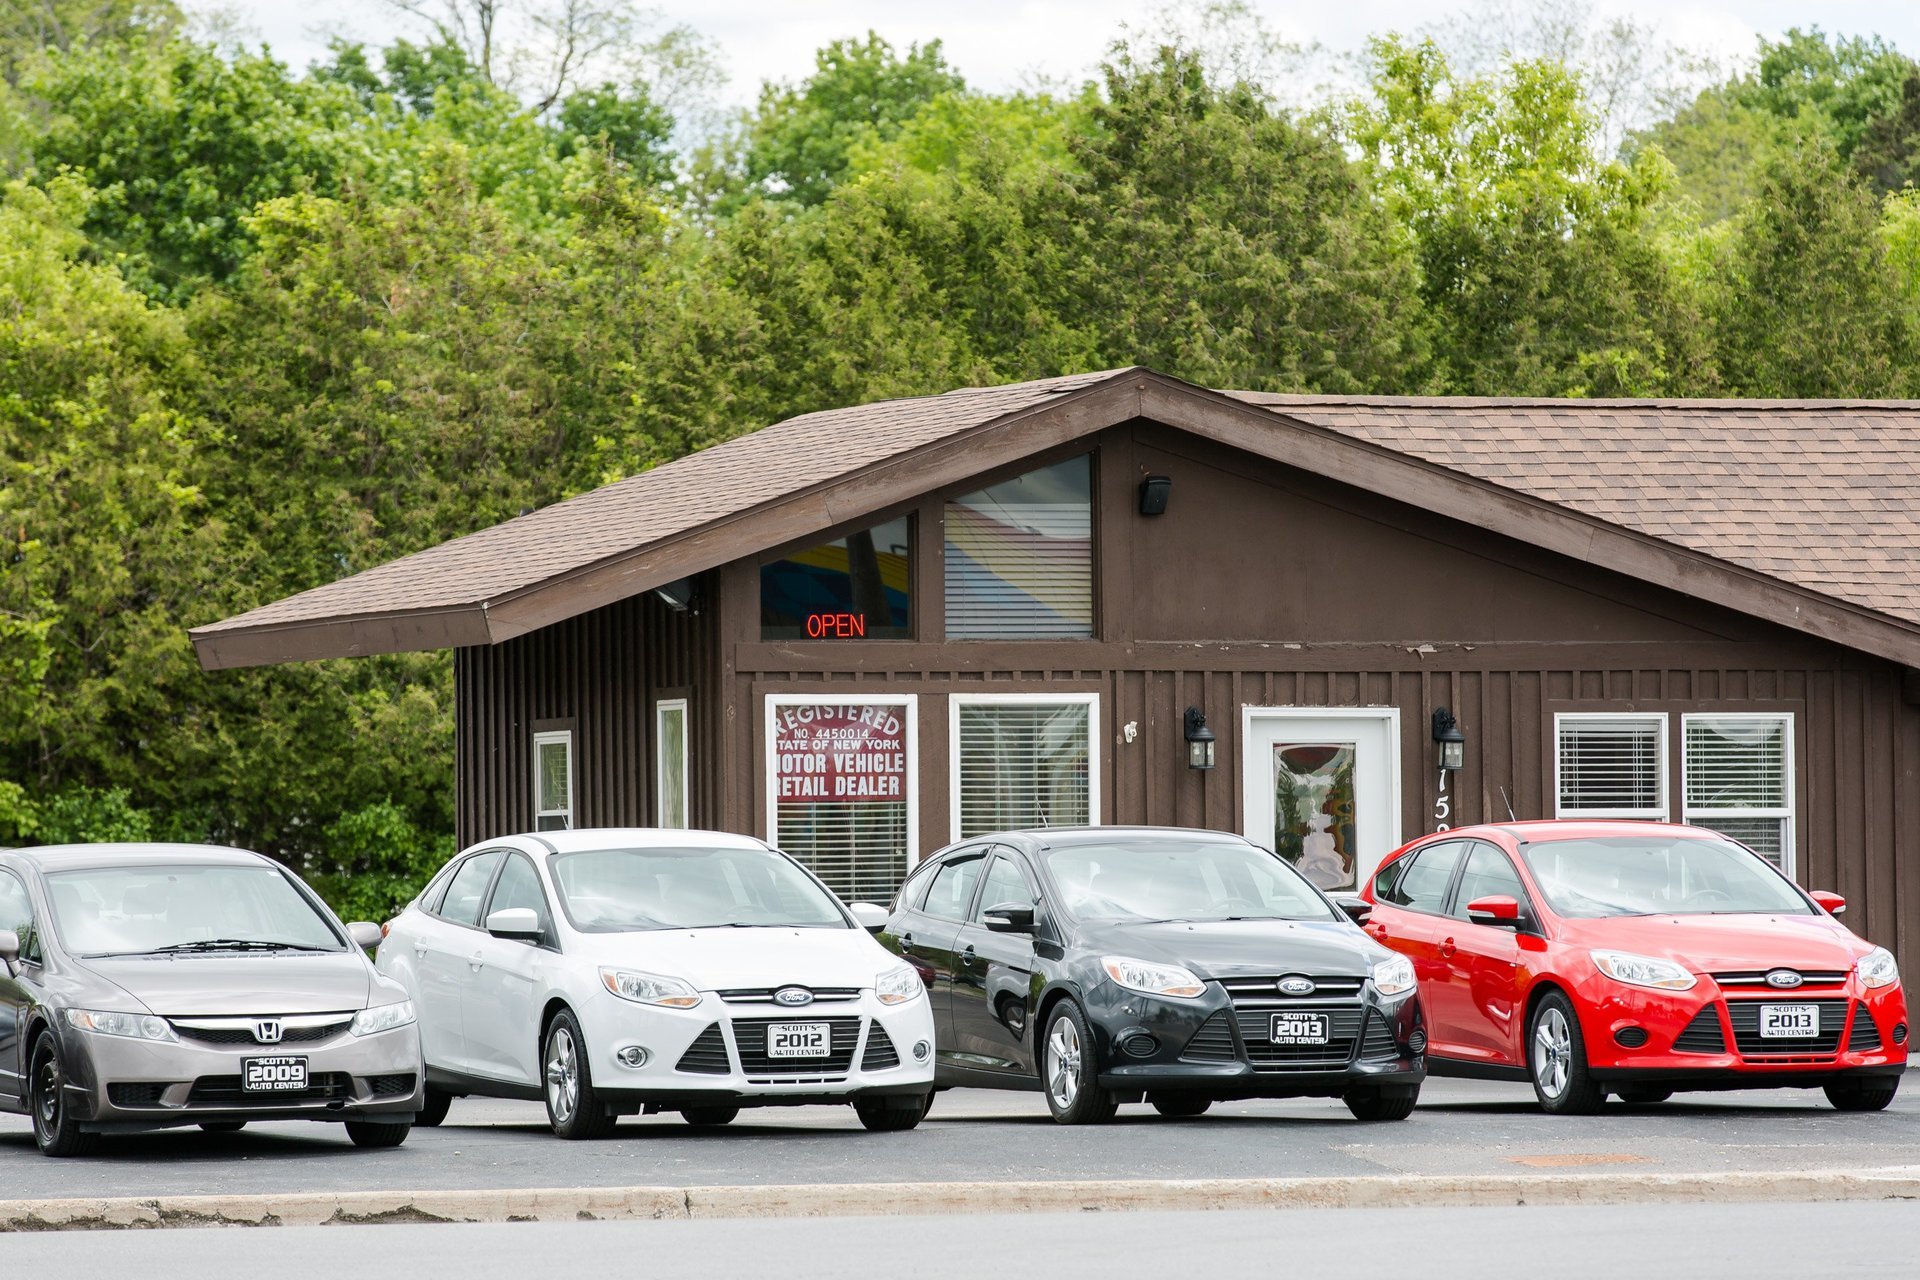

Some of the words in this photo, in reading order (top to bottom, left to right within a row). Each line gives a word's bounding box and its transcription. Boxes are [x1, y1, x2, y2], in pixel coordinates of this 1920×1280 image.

[807, 613, 864, 637] OPEN
[794, 728, 810, 739] NO.
[815, 728, 869, 739] 4450014
[776, 740, 808, 750] TATE
[812, 740, 829, 750] OF
[833, 740, 861, 750] NEW
[866, 740, 900, 750] YORK
[833, 753, 904, 773] VEHICLE
[835, 776, 900, 796] DEALER
[1768, 1014, 1811, 1028] 2013
[1277, 1021, 1322, 1036] 2013
[776, 1033, 822, 1047] 2012
[1274, 1036, 1295, 1044] AUTO
[1296, 1036, 1325, 1044] CENTER
[258, 1057, 296, 1065] SCOTT'S
[249, 1065, 304, 1081] 2009
[249, 1082, 272, 1090] AUTO
[274, 1081, 304, 1090] CENTER
